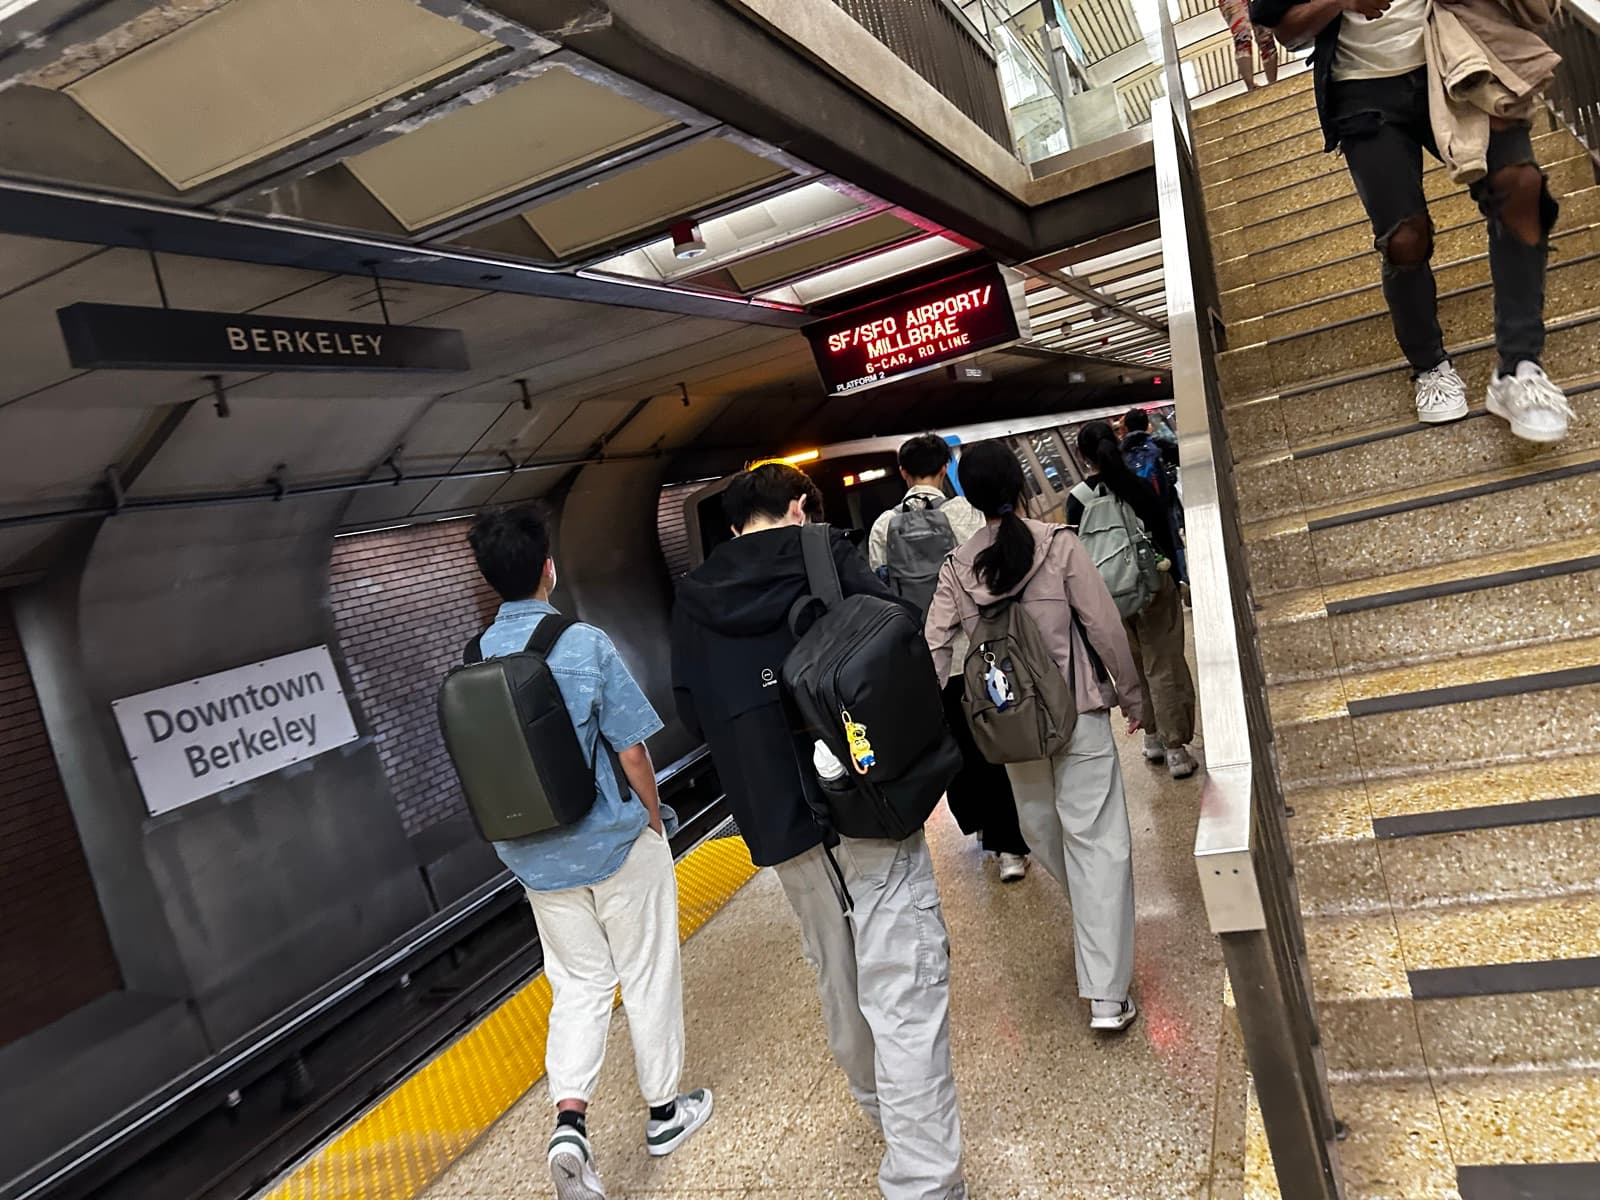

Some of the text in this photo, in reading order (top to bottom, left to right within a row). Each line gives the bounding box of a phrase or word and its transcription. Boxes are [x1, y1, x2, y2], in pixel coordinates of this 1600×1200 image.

[828, 285, 992, 352] SF/SFO AIRPORT/
[868, 316, 959, 359] MILLBRAE
[226, 327, 382, 355] BERKELEY
[866, 333, 970, 374] 6-CAR, RD LINE
[836, 371, 885, 392] PLATFORM 2
[144, 670, 325, 743] Downtown
[184, 713, 316, 778] Berkeley
